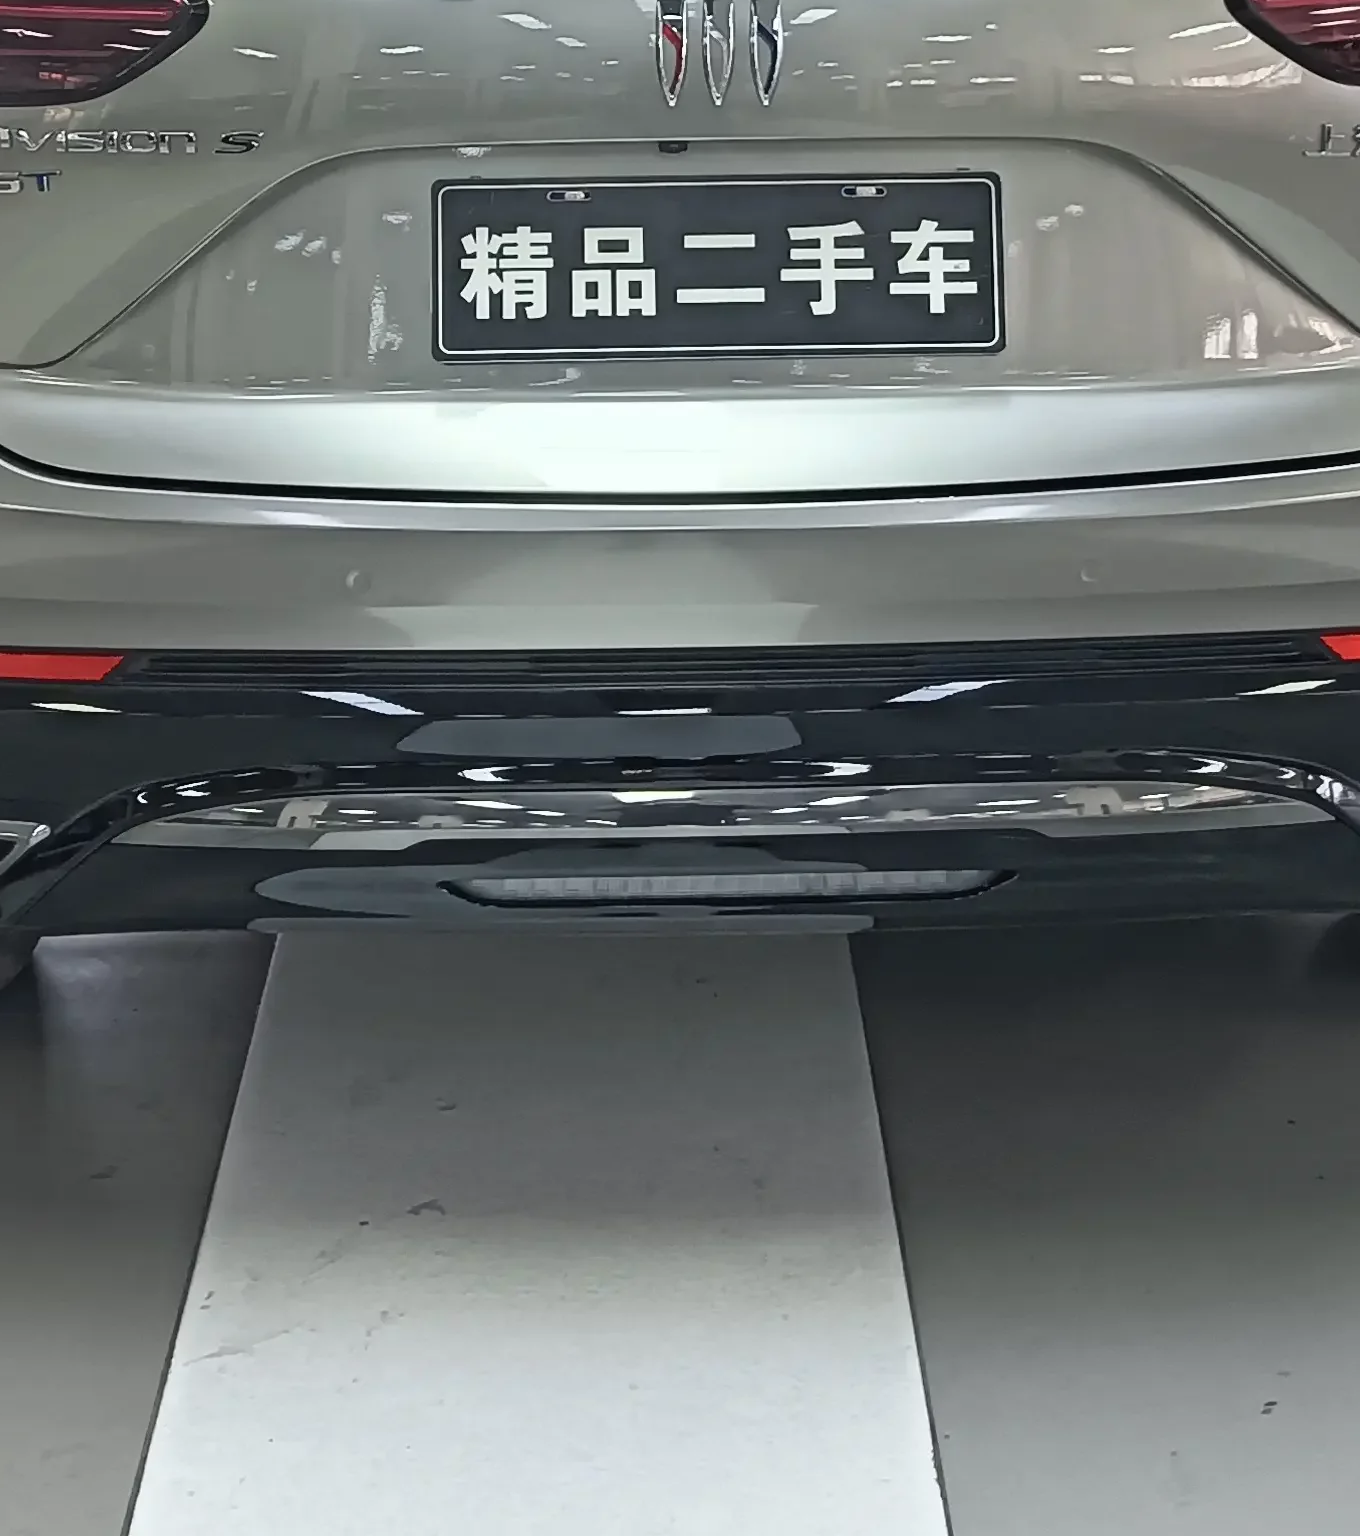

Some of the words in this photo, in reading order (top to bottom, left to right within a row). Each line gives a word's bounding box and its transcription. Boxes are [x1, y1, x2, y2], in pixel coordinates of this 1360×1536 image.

[213, 130, 265, 155] S
[460, 219, 979, 320] 精品二手车
